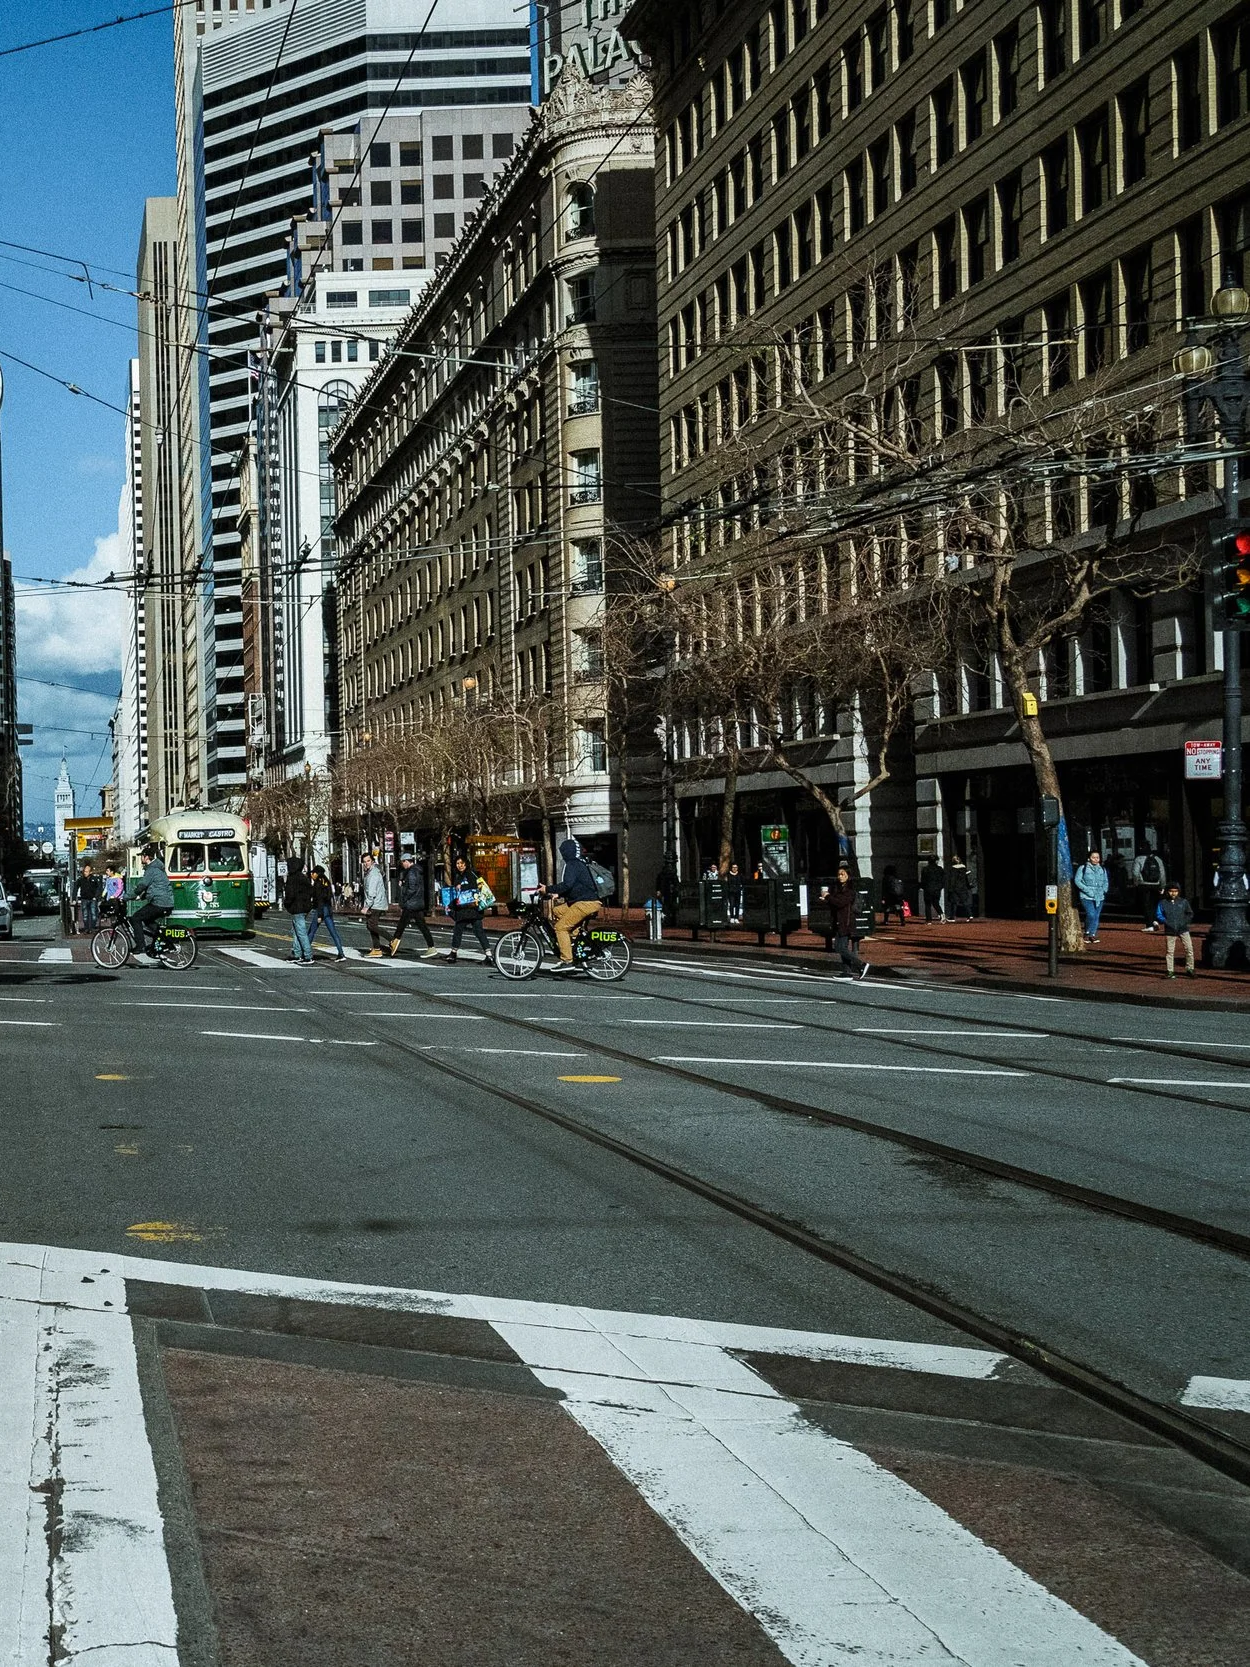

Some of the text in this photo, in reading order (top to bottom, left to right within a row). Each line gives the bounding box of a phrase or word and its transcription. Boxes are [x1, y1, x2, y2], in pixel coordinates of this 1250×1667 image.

[1186, 747, 1197, 755] NO
[183, 831, 205, 839] MARKET
[208, 830, 234, 838] CASTRO
[164, 928, 186, 938] Plus
[591, 930, 618, 942] Plus
